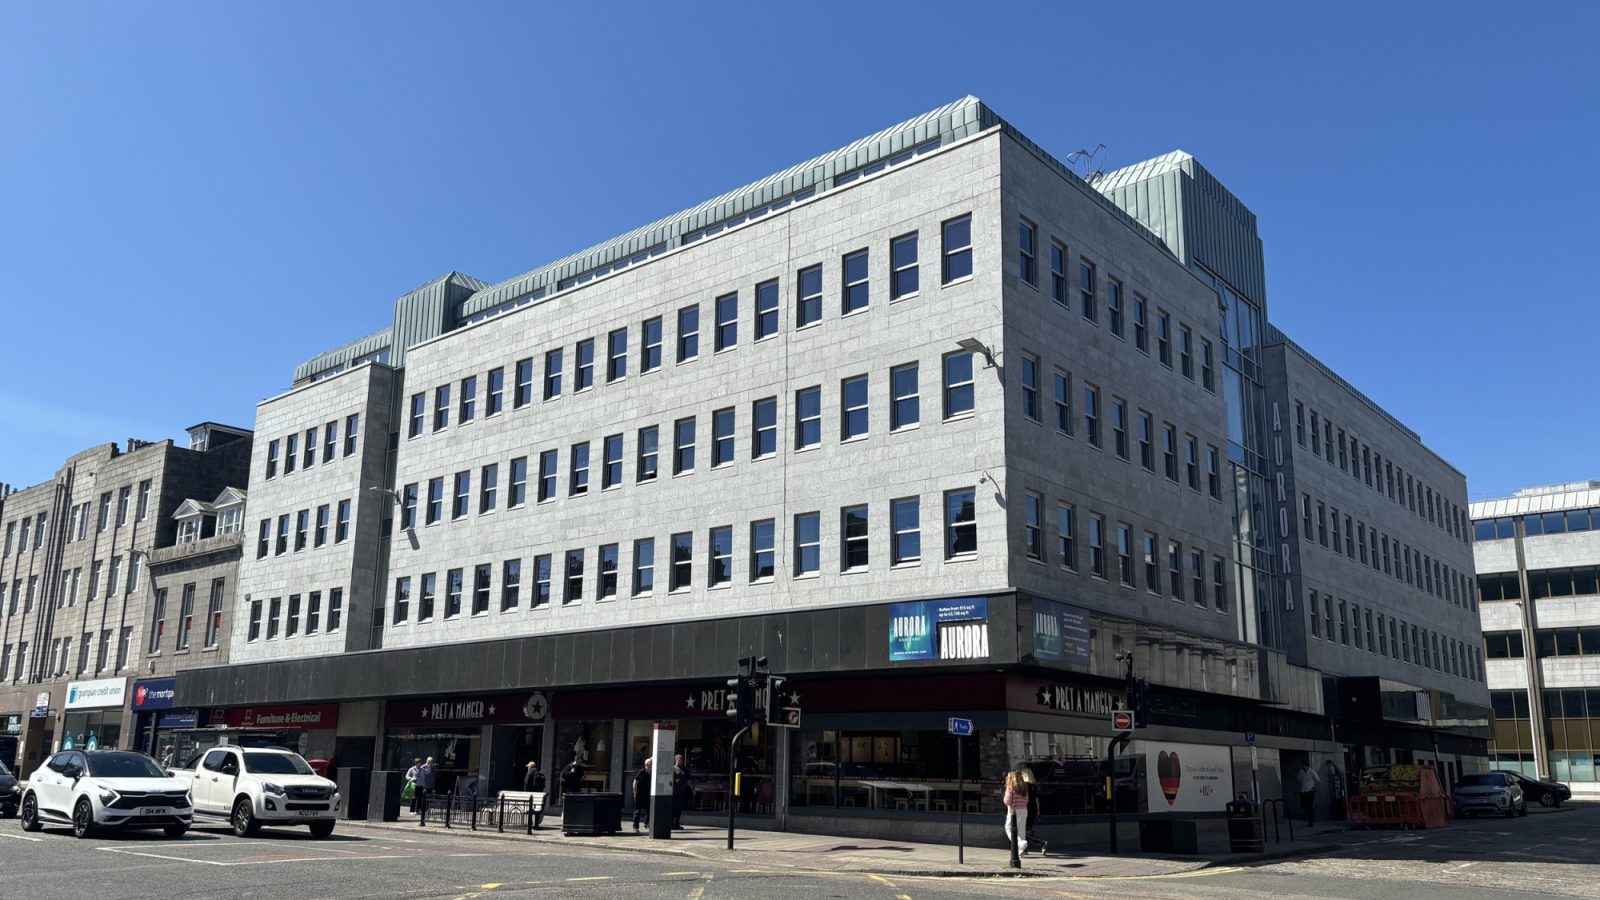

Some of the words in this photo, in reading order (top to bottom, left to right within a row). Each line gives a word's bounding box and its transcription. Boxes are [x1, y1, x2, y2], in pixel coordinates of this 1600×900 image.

[1273, 402, 1295, 611] AURORA
[893, 615, 926, 638] AURORA
[1035, 612, 1059, 637] AURORA
[941, 624, 990, 660] AURORA
[431, 702, 448, 720] PRET
[448, 702, 454, 719] A
[455, 701, 484, 719] MANGER
[701, 689, 726, 711] PRET
[1055, 685, 1074, 711] PRET
[1076, 690, 1082, 712] A
[1083, 689, 1113, 715] MANGER
[256, 713, 285, 724] Furniture
[291, 711, 321, 723] Electrical
